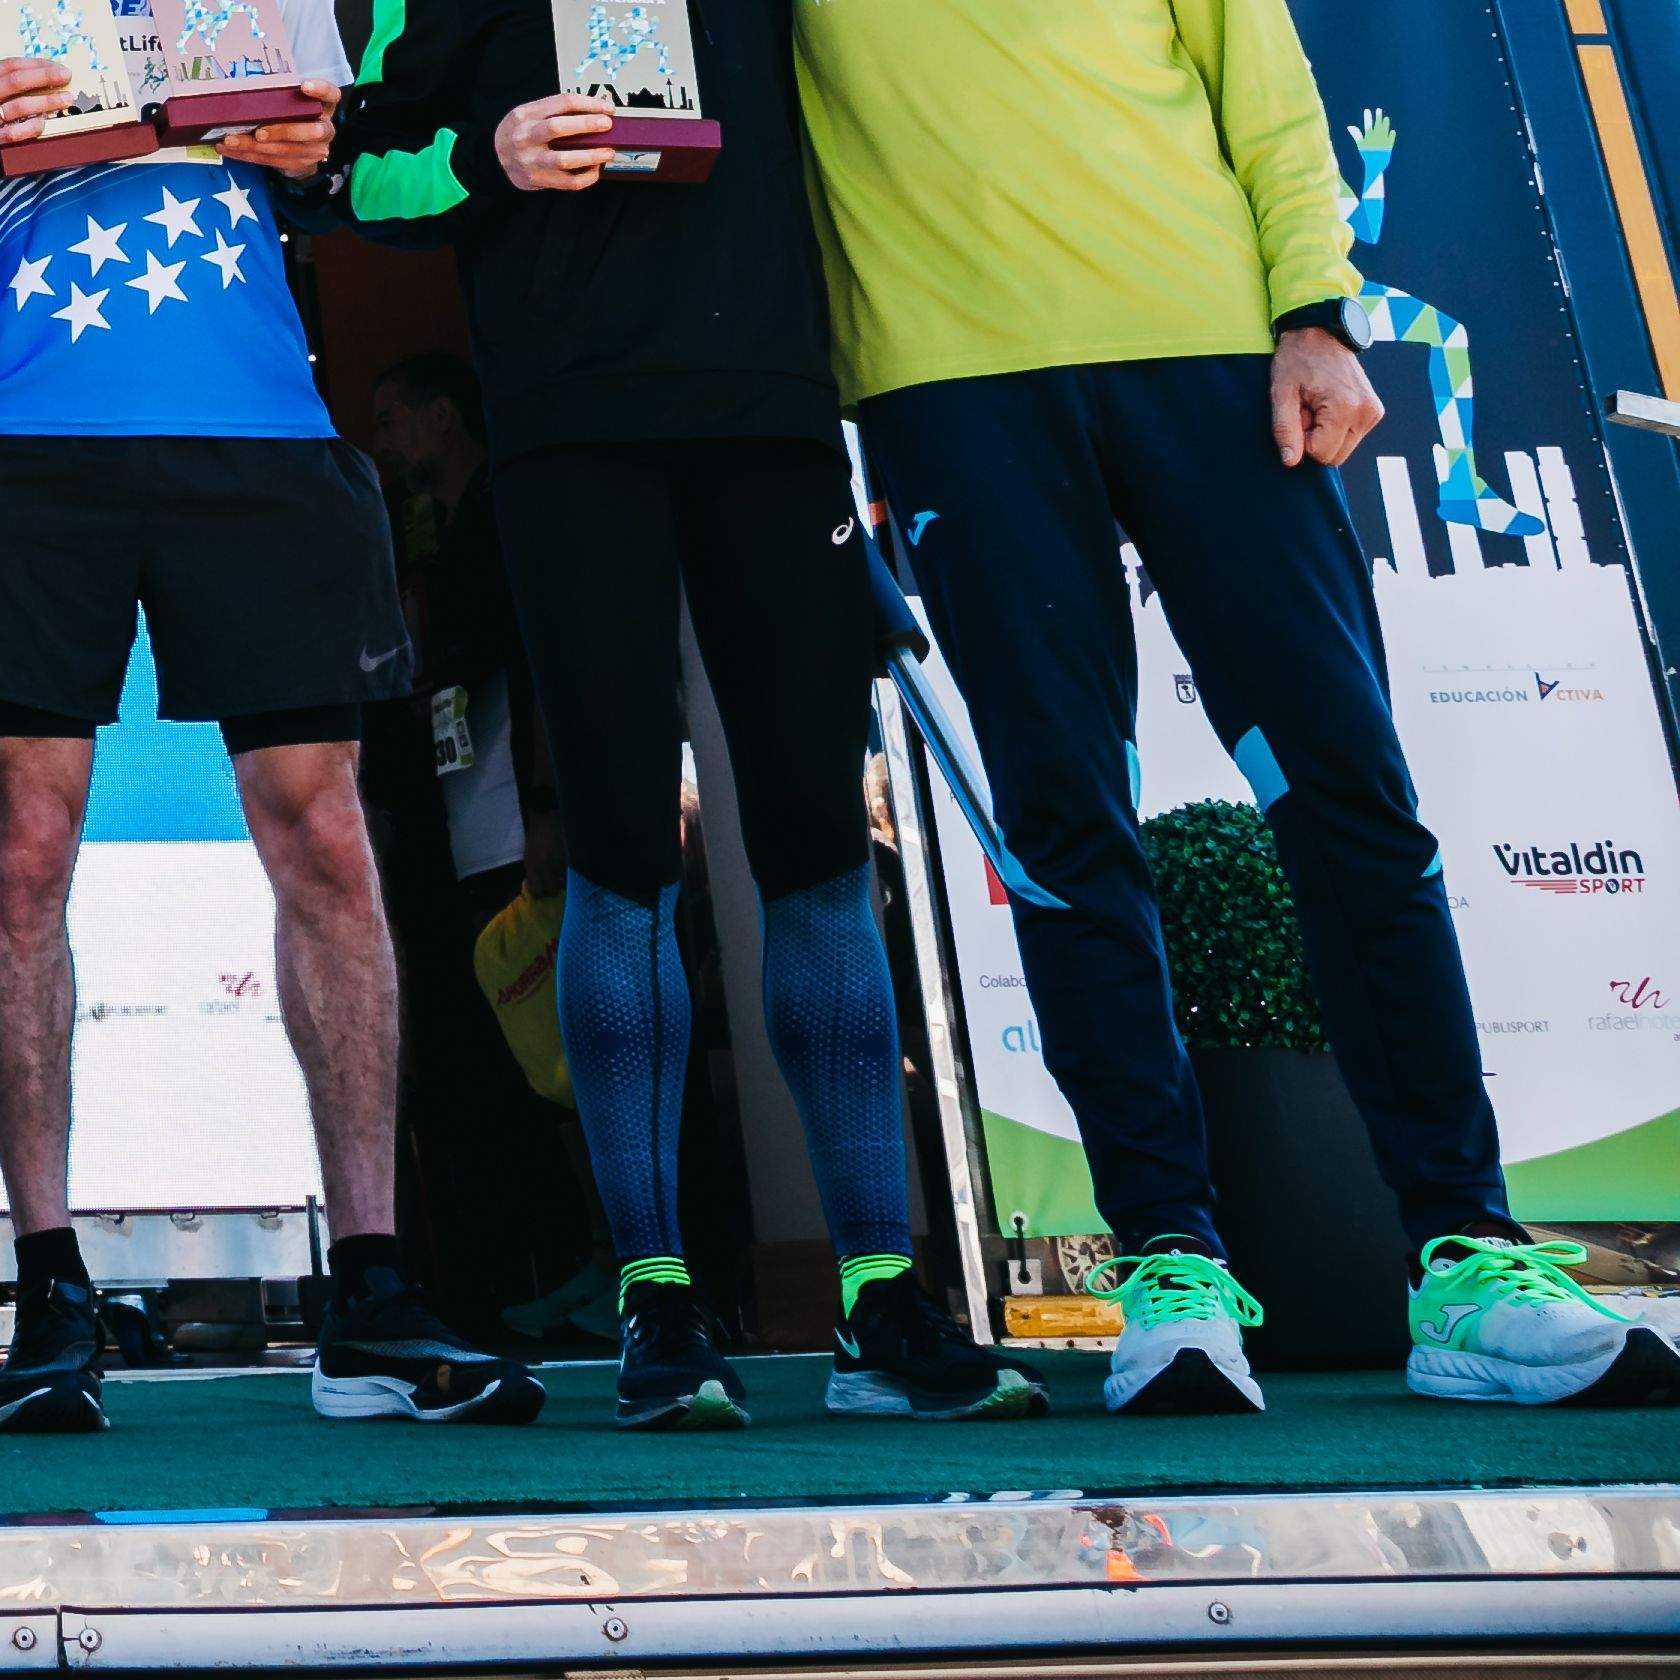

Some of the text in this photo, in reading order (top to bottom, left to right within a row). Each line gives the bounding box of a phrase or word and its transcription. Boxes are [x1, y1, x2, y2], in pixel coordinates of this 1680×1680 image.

[1429, 686, 1529, 704] EDUCACIÓN
[1491, 839, 1646, 877] Vitaldin
[1579, 877, 1646, 895] SPORT
